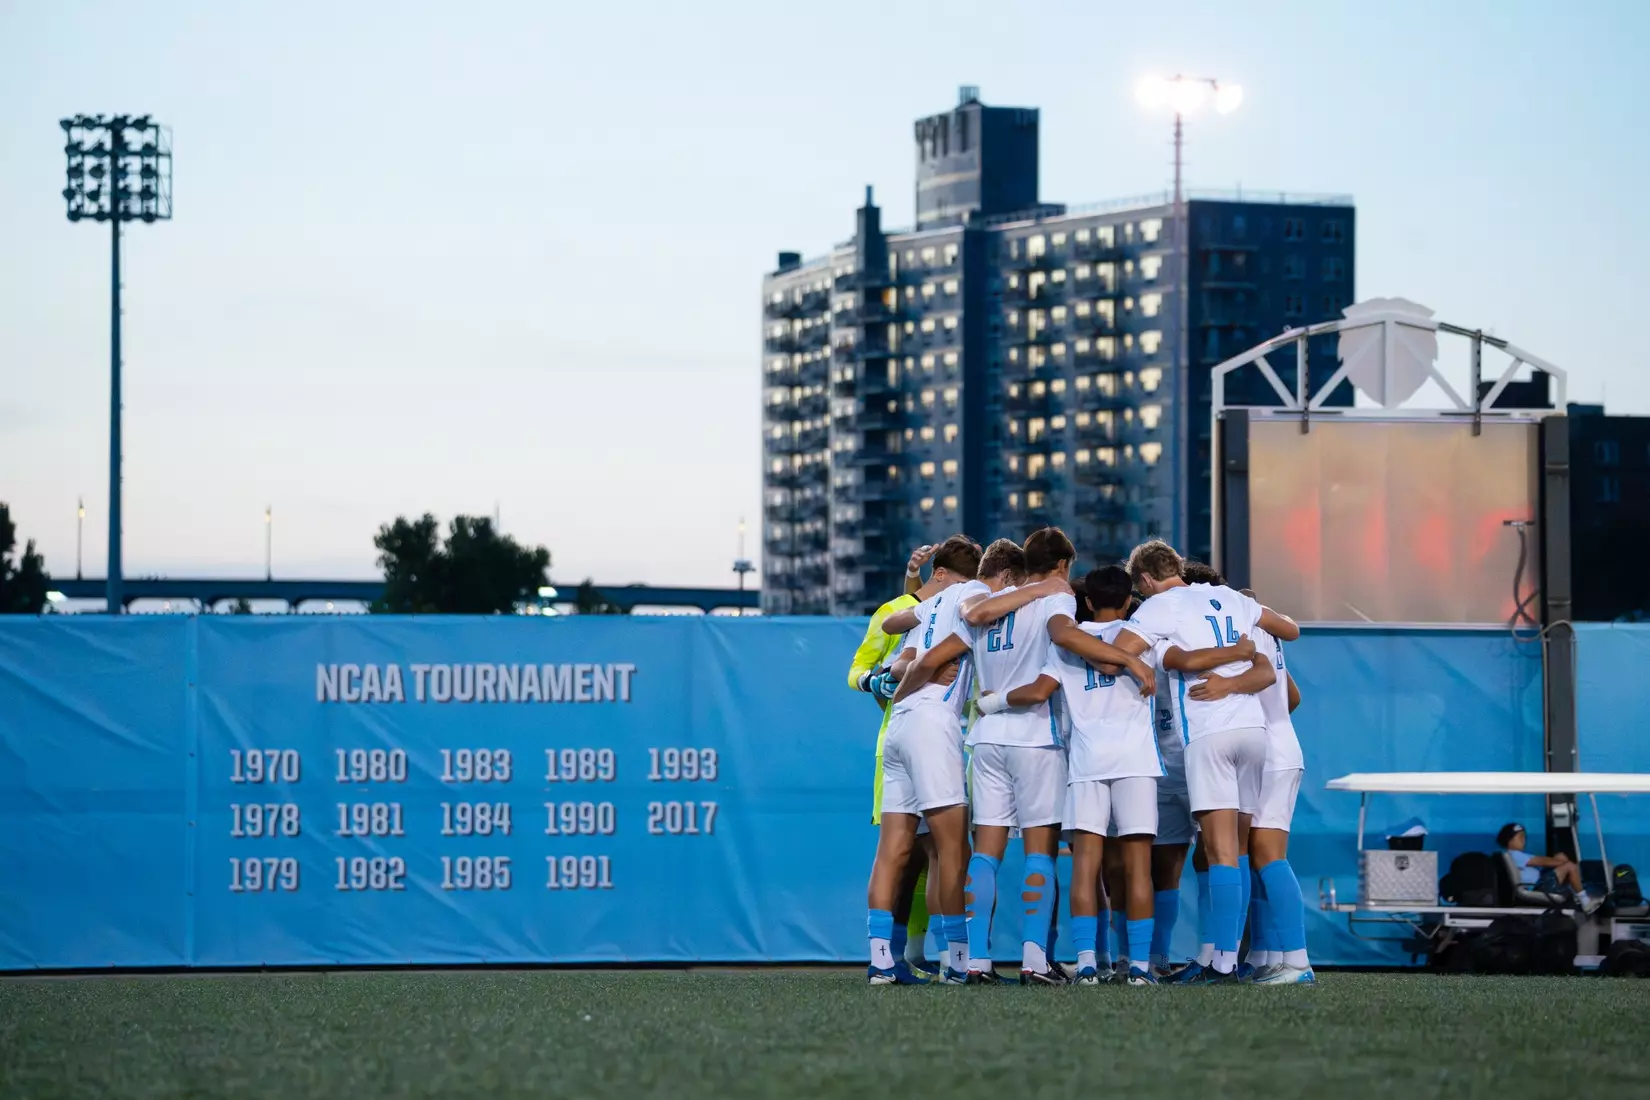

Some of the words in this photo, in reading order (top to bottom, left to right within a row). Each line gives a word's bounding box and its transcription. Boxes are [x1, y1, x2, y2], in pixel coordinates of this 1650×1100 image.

[987, 611, 1016, 652] 21
[1204, 615, 1240, 648] 14
[316, 663, 404, 702] NCAA
[409, 663, 635, 702] TOURNAMENT
[229, 748, 299, 783] 1970
[335, 748, 407, 782] 1980
[440, 748, 511, 782] 1983
[544, 747, 615, 781] 1989
[647, 747, 717, 781] 1993
[229, 803, 299, 837] 1978
[335, 802, 405, 836] 1981
[440, 802, 511, 836] 1984
[544, 801, 615, 835] 1990
[647, 800, 717, 835] 2017
[228, 857, 298, 891] 1979
[335, 856, 405, 890] 1982
[440, 856, 511, 890] 1985
[545, 855, 613, 889] 1991
